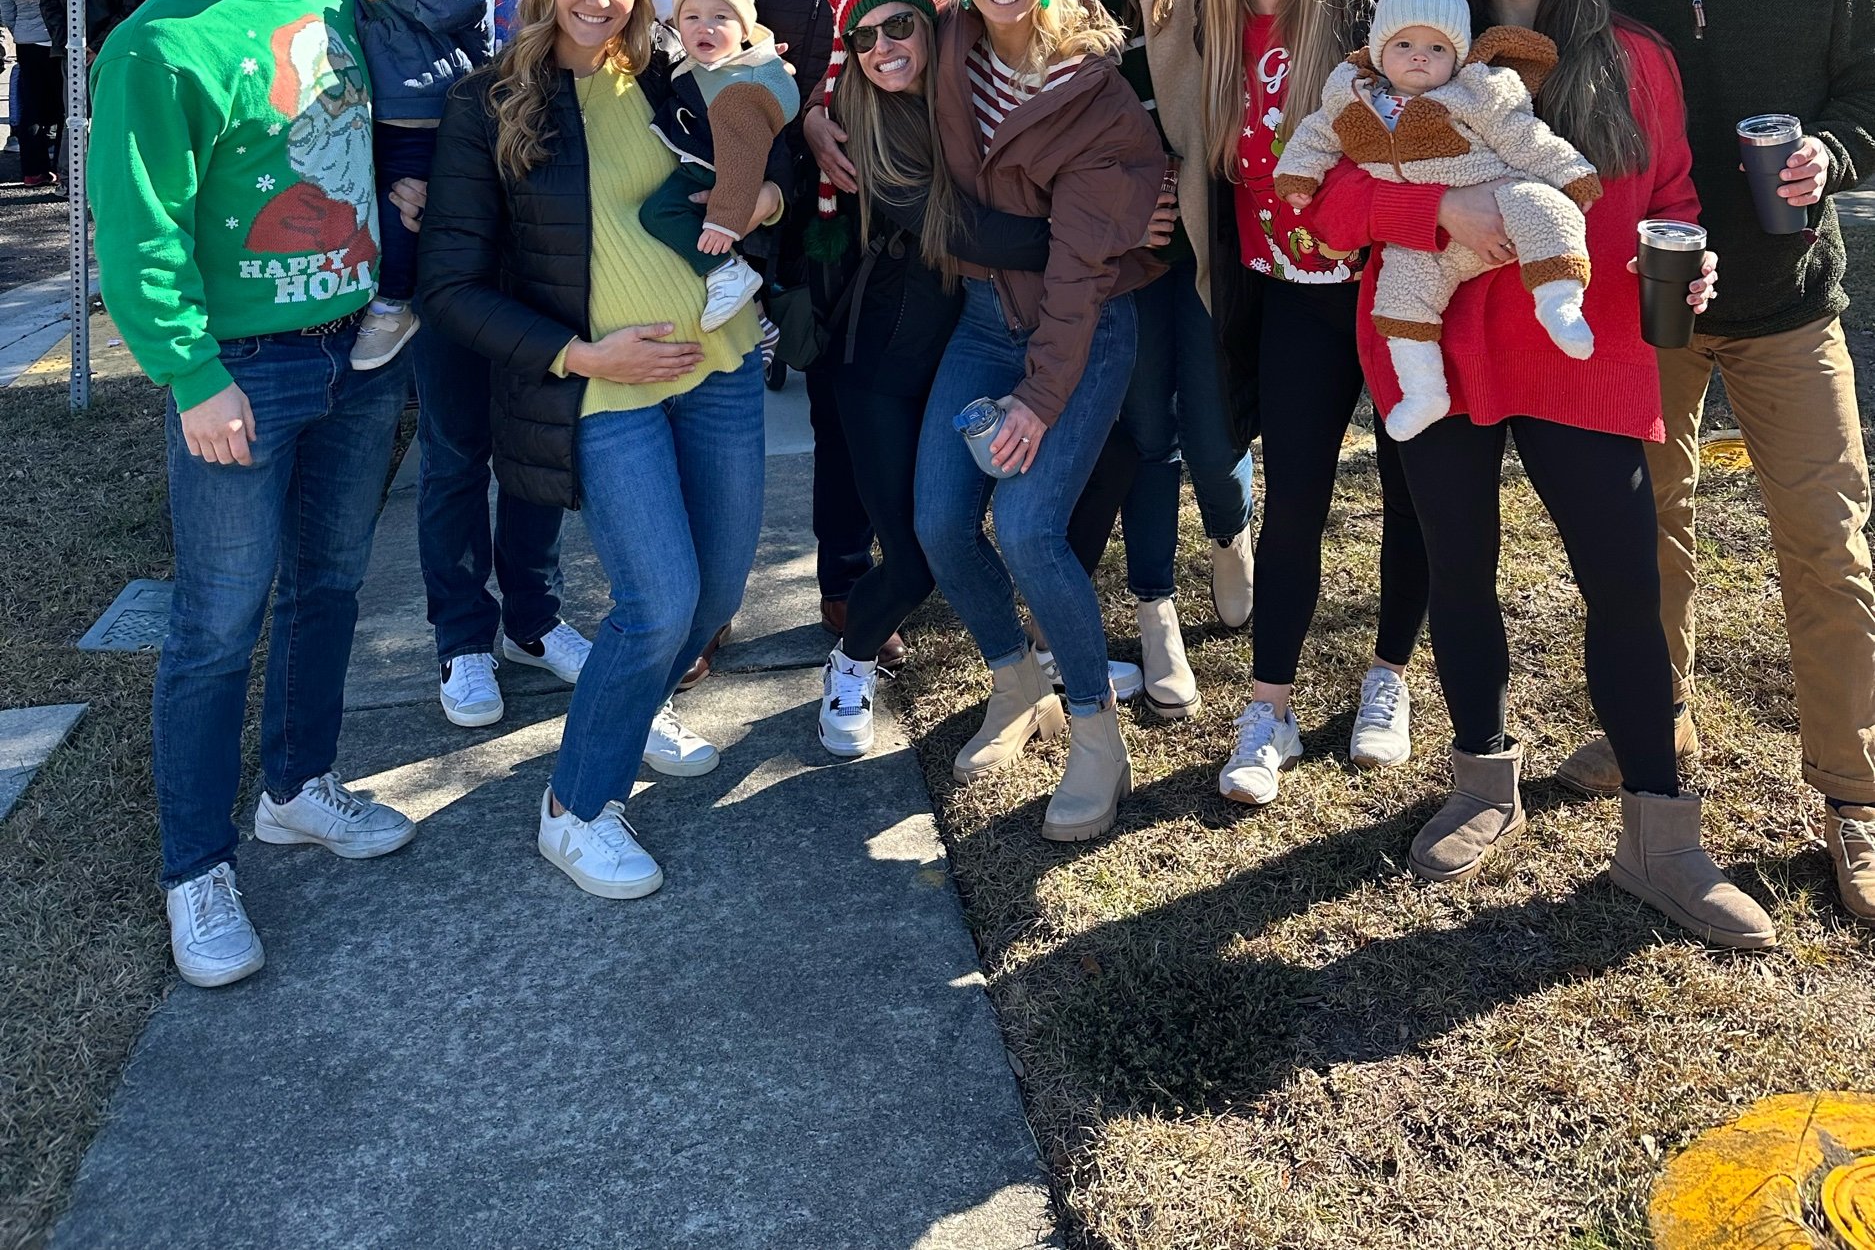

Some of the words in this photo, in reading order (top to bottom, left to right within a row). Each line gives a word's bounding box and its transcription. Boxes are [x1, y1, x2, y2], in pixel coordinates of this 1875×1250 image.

[1257, 47, 1292, 94] G
[238, 248, 350, 279] HAPPY
[274, 260, 380, 304] HOLI
